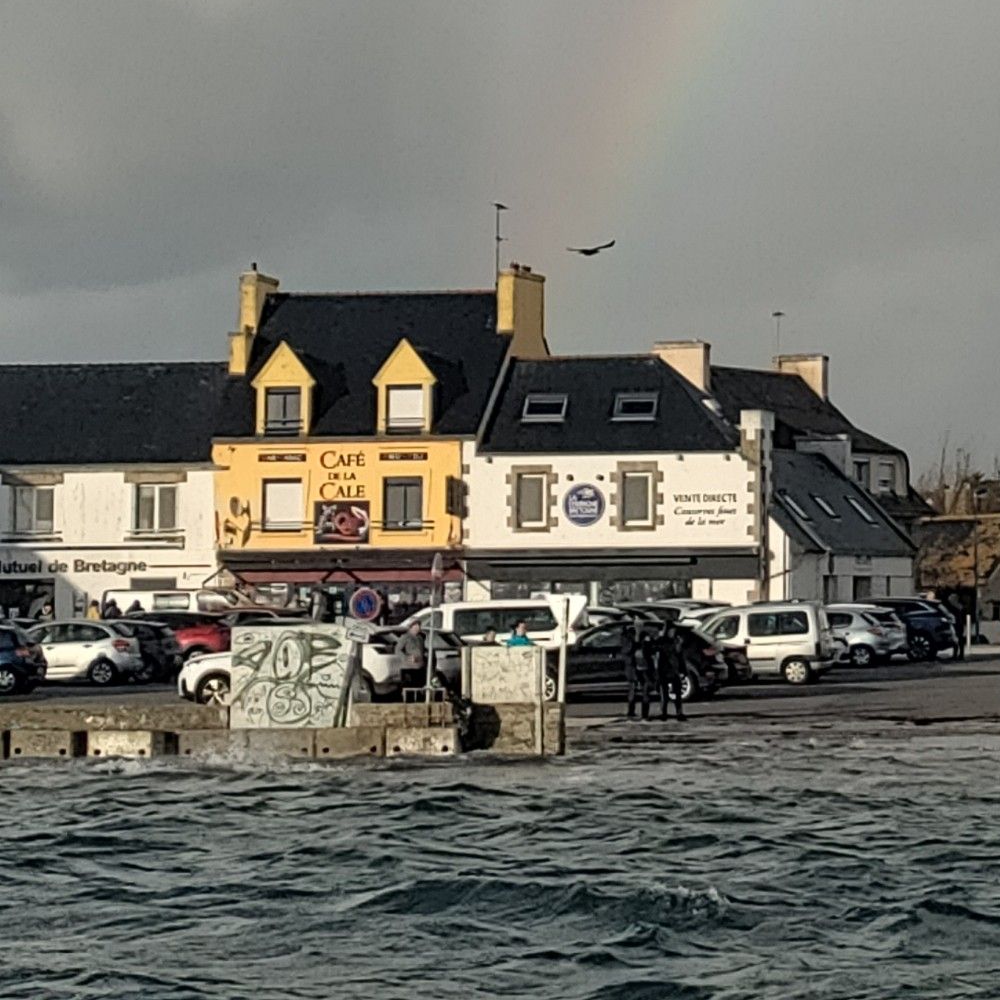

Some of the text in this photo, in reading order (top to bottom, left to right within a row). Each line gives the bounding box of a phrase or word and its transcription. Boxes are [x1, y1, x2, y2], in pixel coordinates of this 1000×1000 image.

[319, 450, 366, 469] CAFÉ
[328, 472, 356, 480] DE LA
[319, 482, 366, 500] CALE
[673, 493, 737, 503] VENTE DIRECTE
[0, 559, 147, 575] utuel de Bretagne
